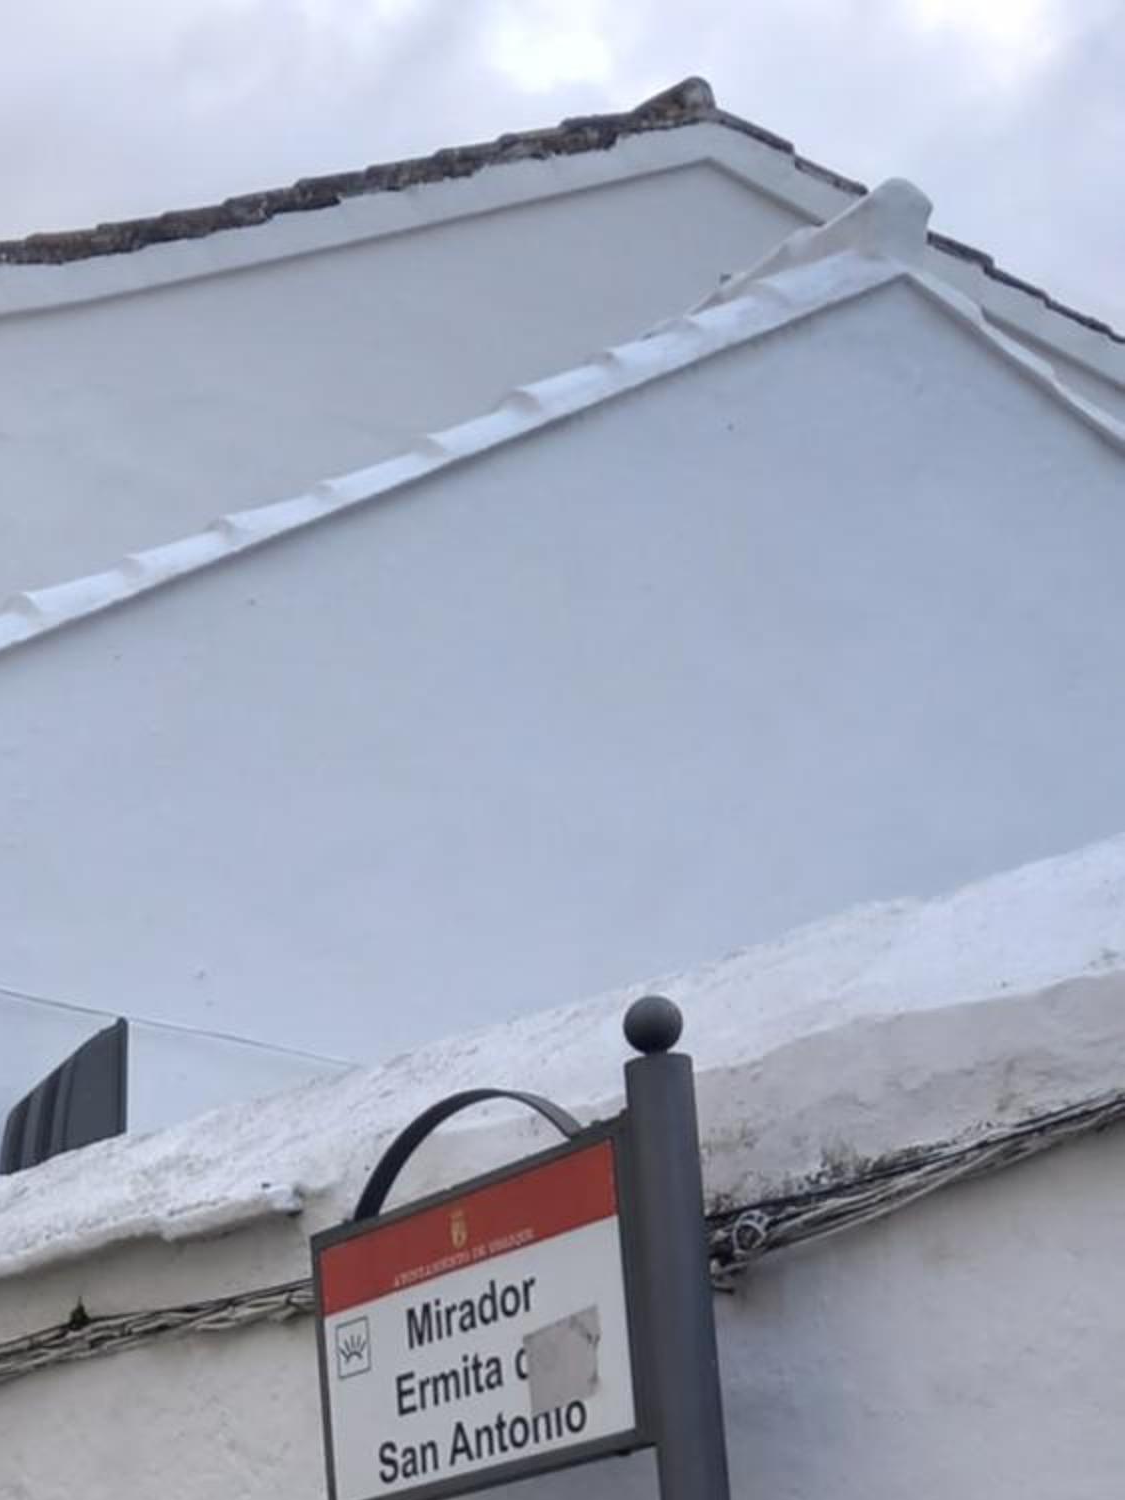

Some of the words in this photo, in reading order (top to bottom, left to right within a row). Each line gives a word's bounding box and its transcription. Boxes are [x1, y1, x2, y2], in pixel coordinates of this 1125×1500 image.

[406, 1277, 536, 1350] Mirador
[396, 1353, 504, 1417] Ermita
[378, 1440, 439, 1484] San
[449, 1399, 587, 1466] Antonio
